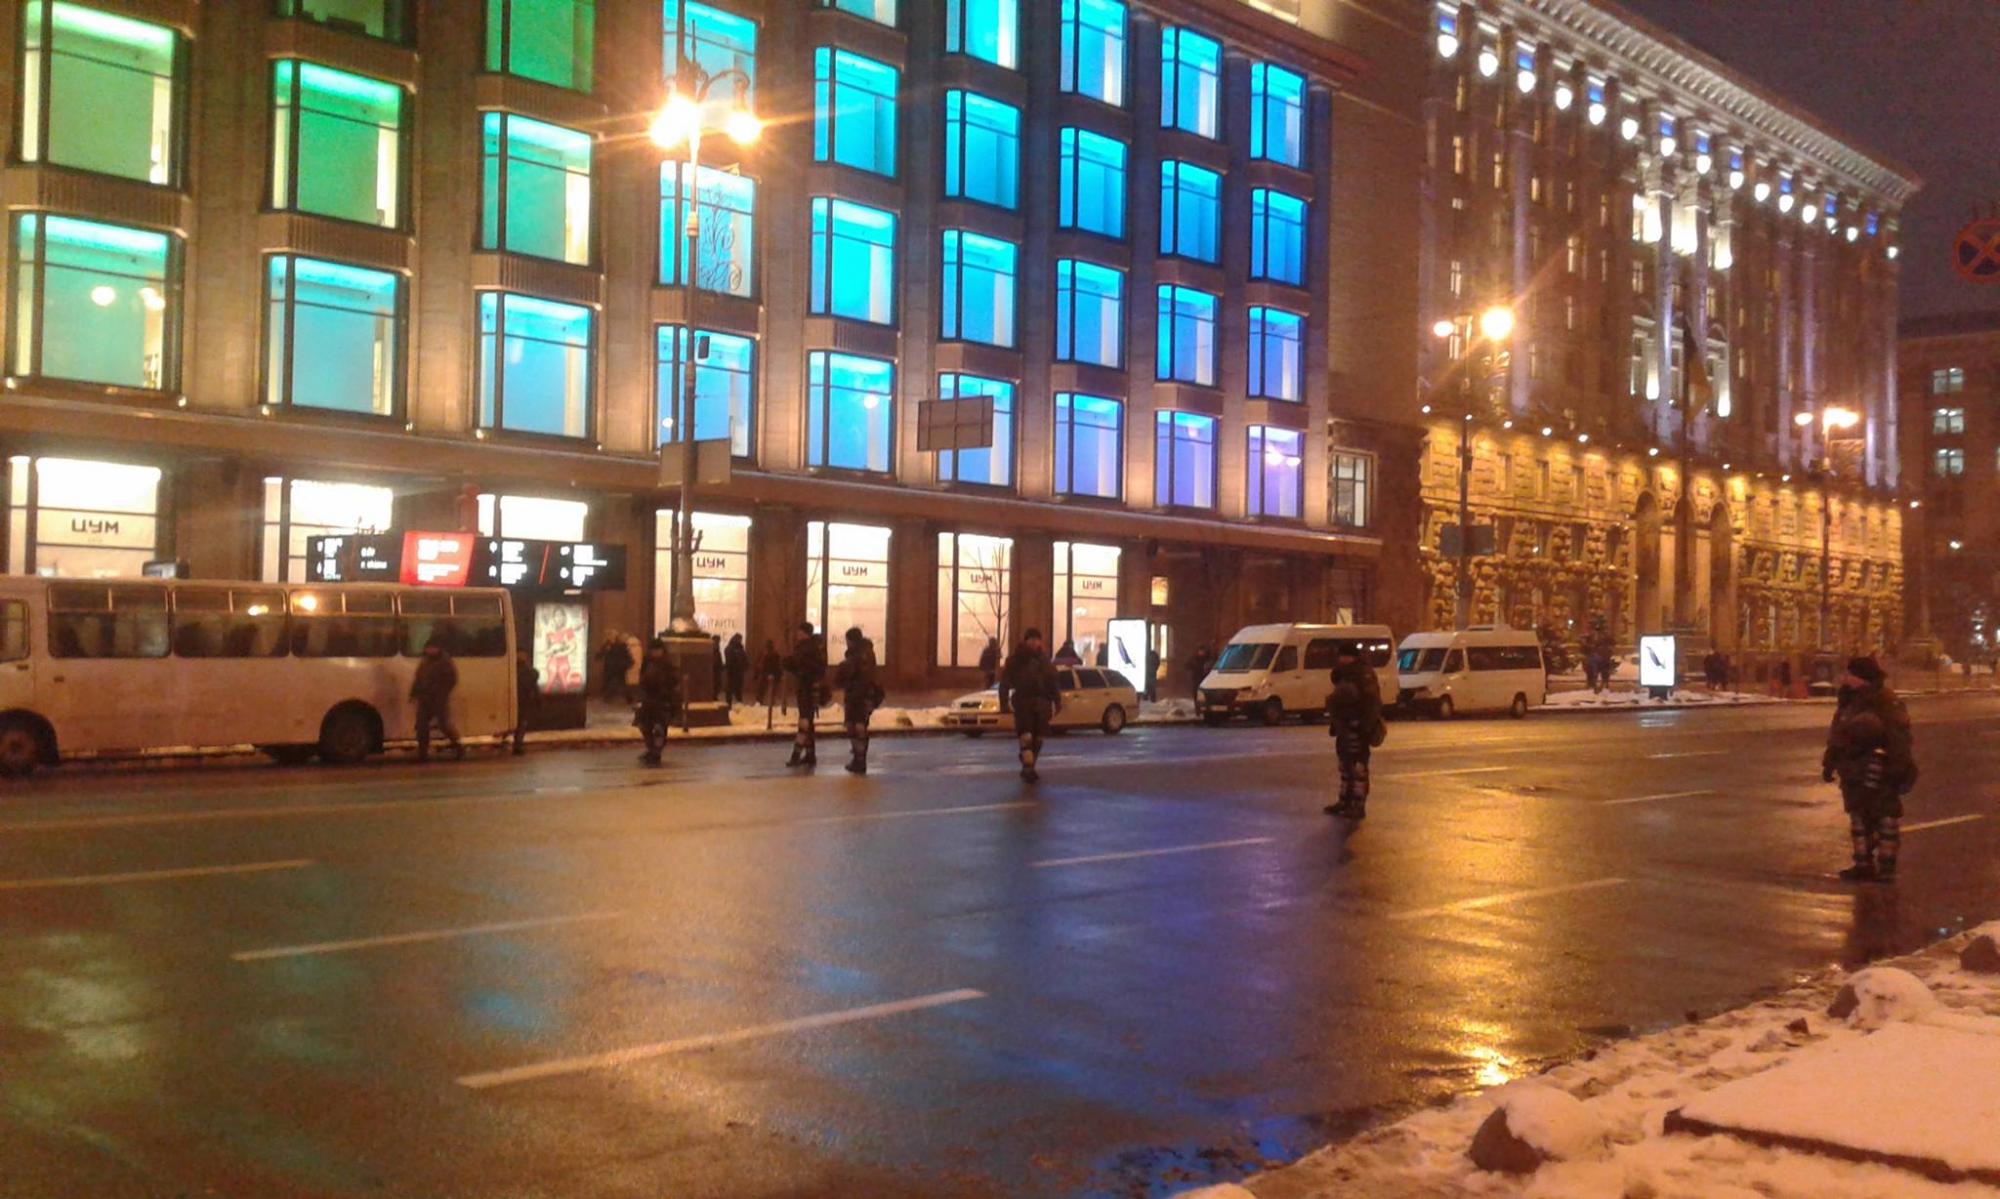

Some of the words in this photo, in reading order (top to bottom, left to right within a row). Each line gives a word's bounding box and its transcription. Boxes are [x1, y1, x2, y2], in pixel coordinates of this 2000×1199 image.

[71, 518, 119, 534] ЦУМ
[695, 556, 725, 568] ЦУМ
[842, 565, 868, 576] ЦУМ
